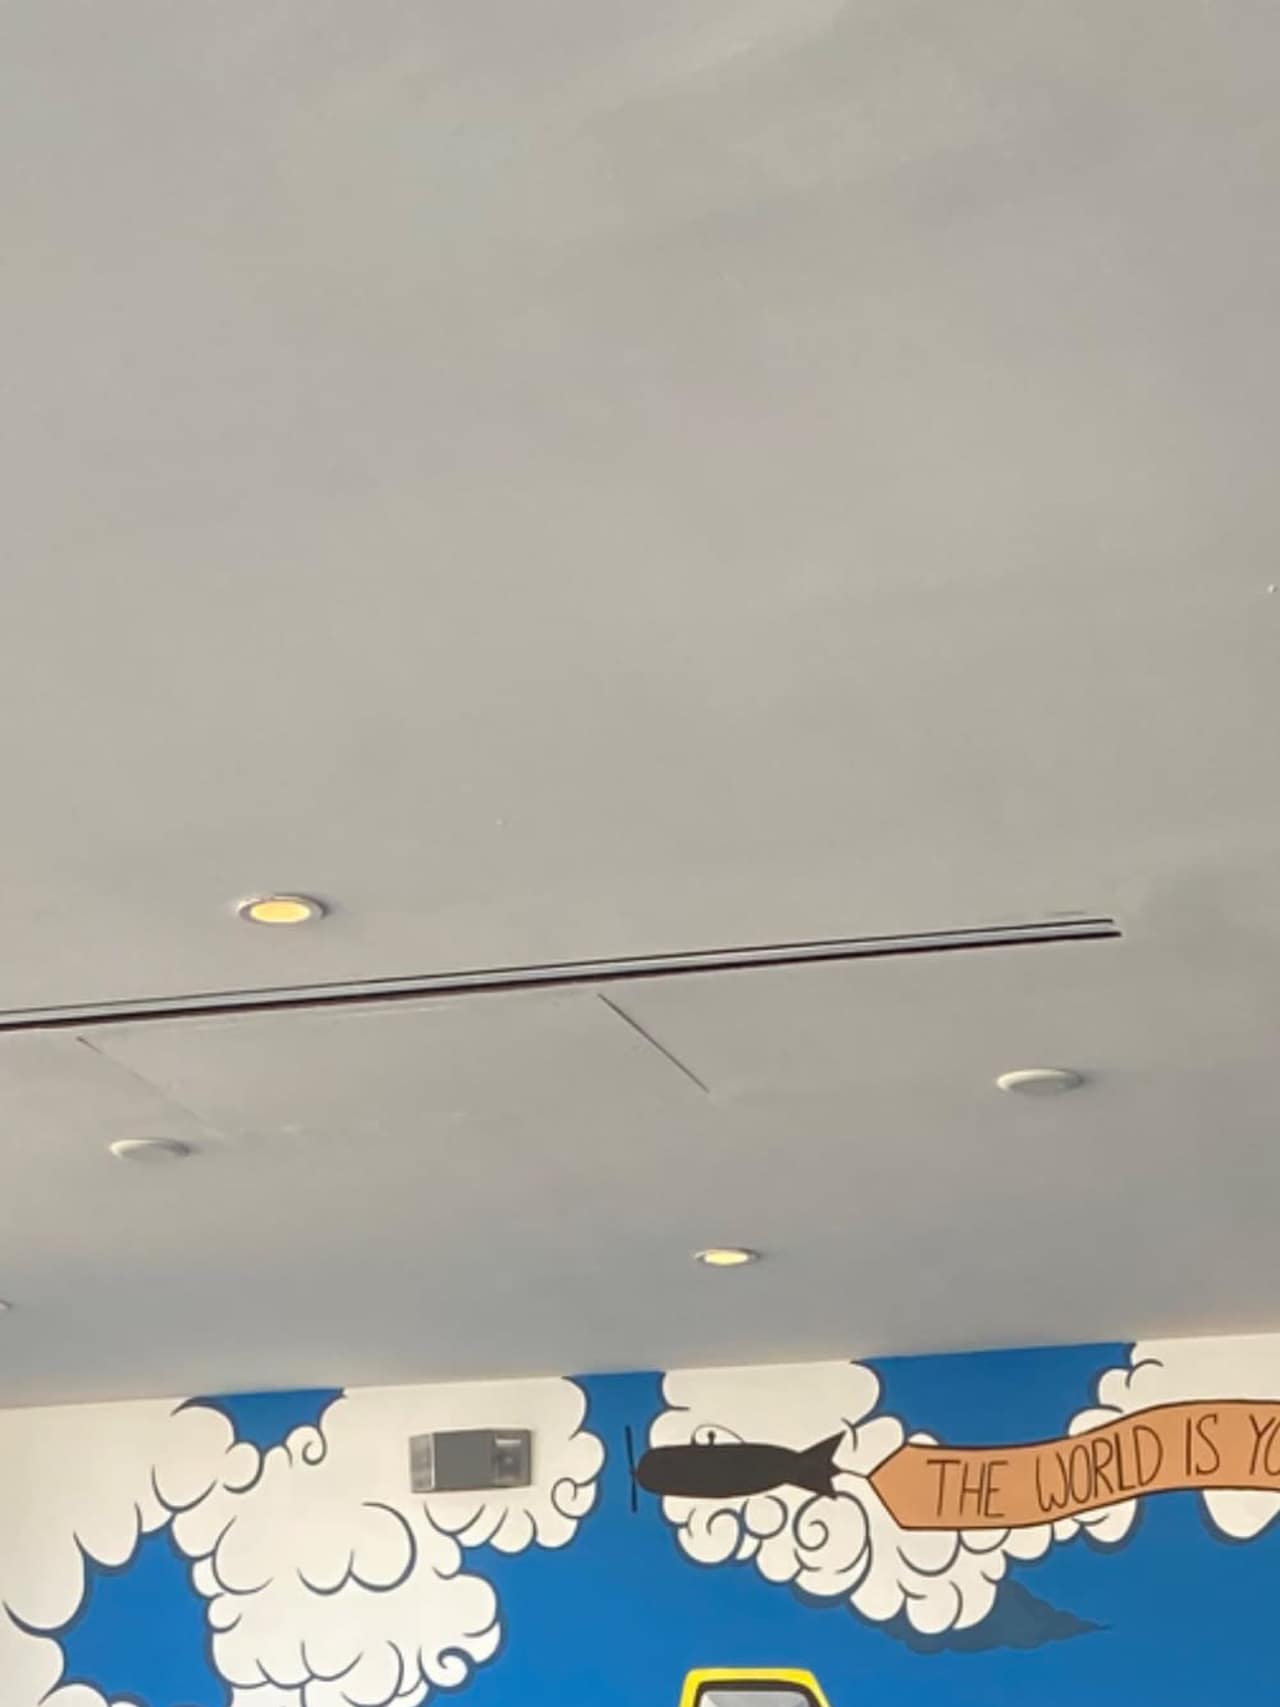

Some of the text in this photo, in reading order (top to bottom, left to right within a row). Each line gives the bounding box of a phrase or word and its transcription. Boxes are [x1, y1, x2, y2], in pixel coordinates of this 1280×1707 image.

[926, 1457, 1009, 1518] THE
[1033, 1424, 1163, 1513] WORLD
[1184, 1413, 1220, 1477] IS
